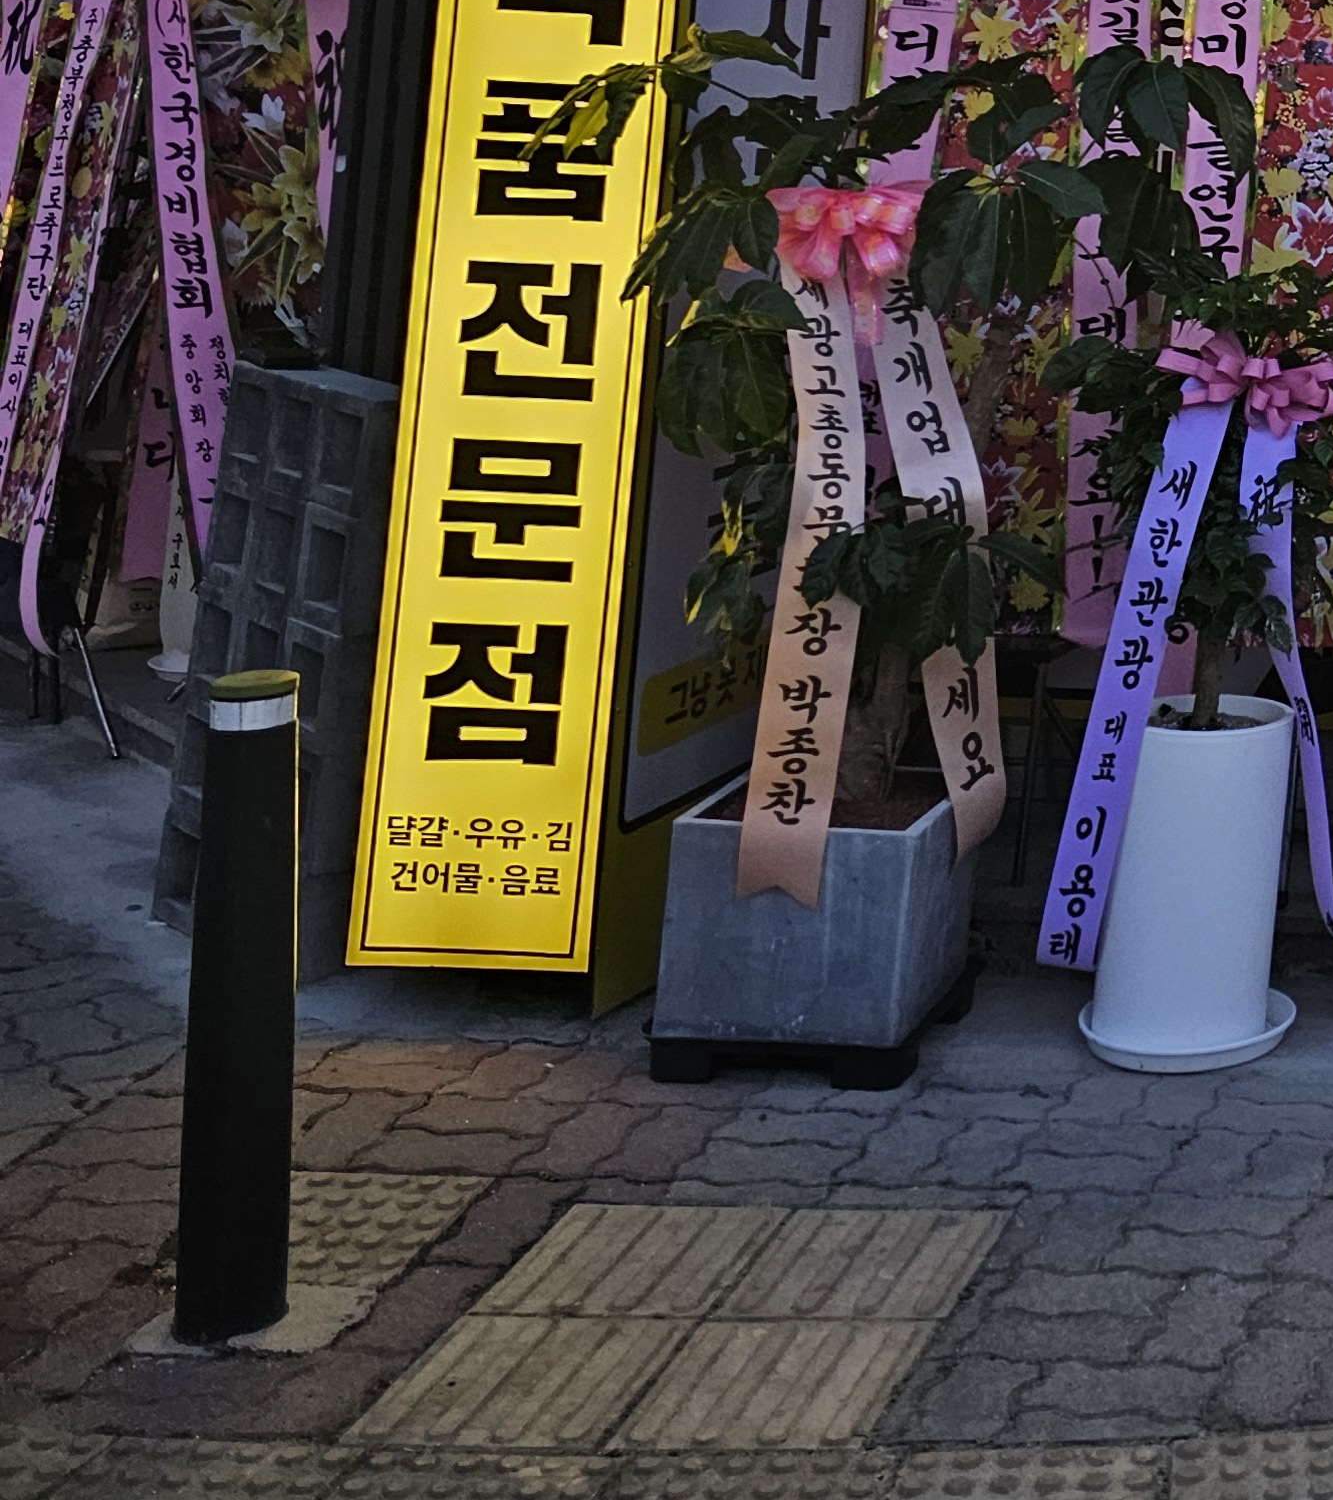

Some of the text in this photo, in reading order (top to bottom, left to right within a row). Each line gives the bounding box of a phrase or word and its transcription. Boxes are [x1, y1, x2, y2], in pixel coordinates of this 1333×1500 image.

[759, 674, 832, 826] 박종찬
[1049, 460, 1199, 965] 새한관광 대표 이용태
[391, 860, 562, 897] 건어물·음료
